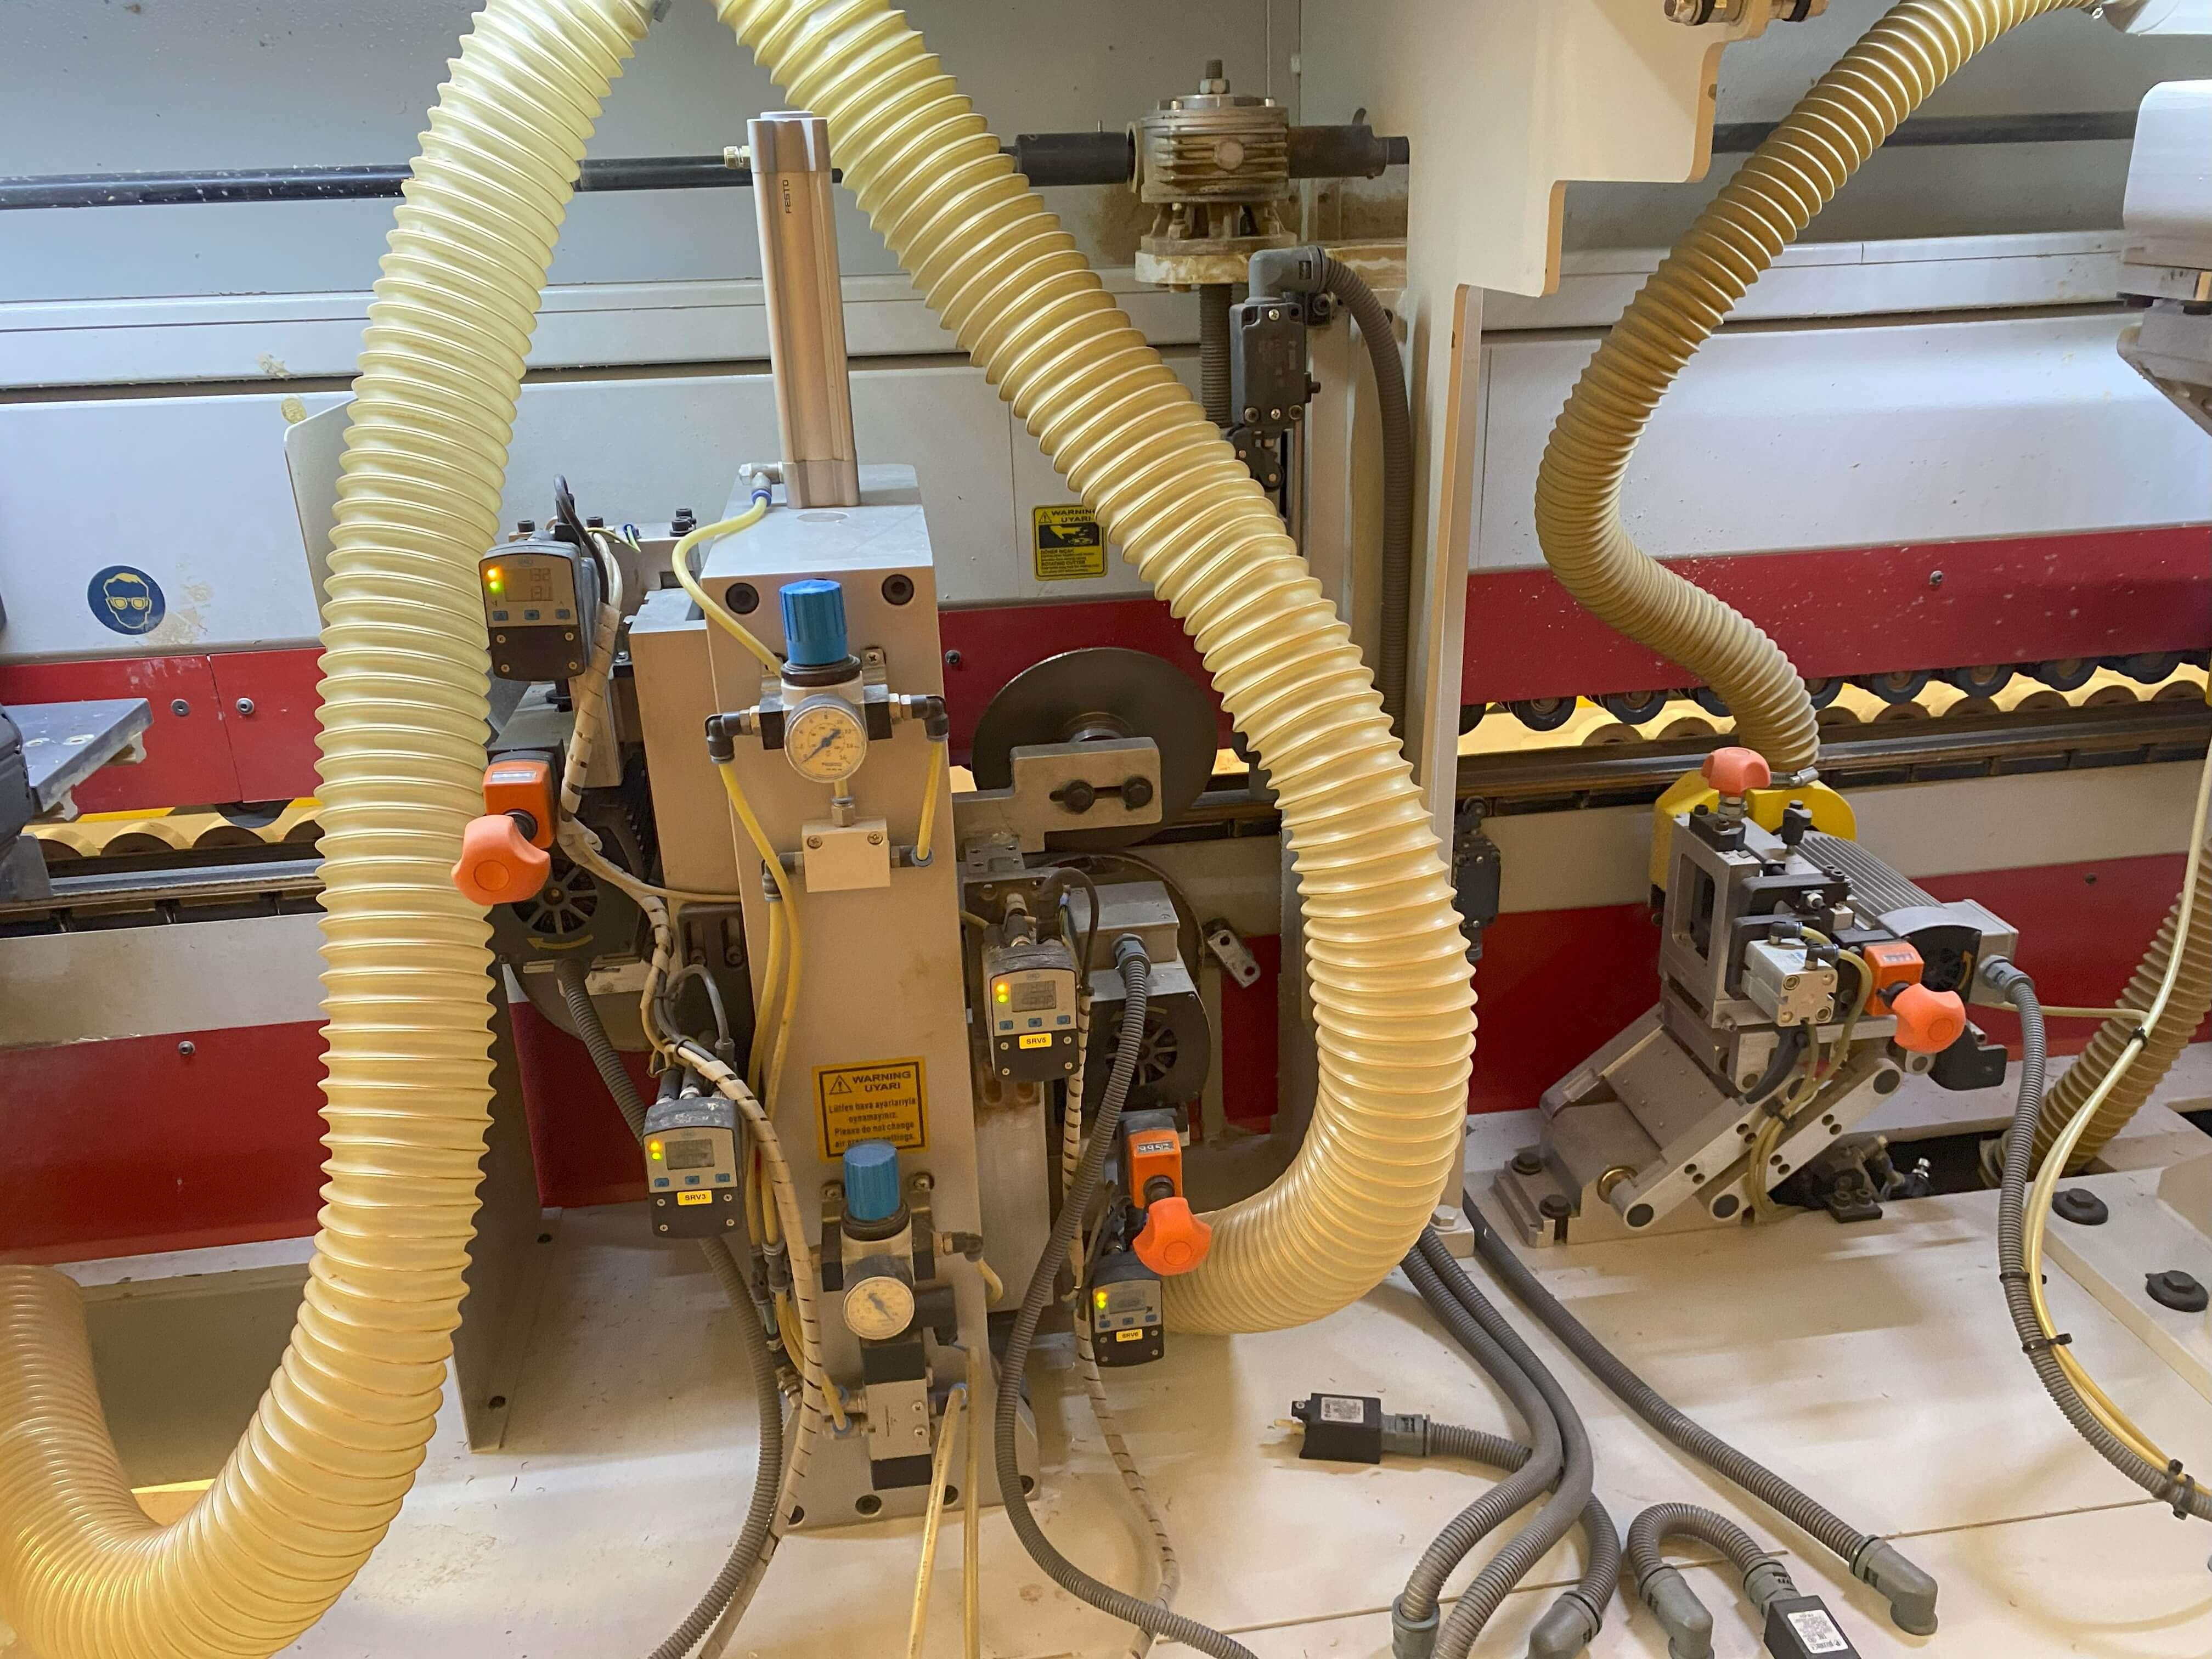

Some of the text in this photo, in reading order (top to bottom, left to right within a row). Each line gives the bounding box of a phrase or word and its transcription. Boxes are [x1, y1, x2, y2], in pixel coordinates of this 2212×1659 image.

[782, 179, 792, 214] FESTO
[852, 1070, 911, 1084] WARNING
[865, 1082, 901, 1092] UYARI
[862, 1125, 871, 1133] do
